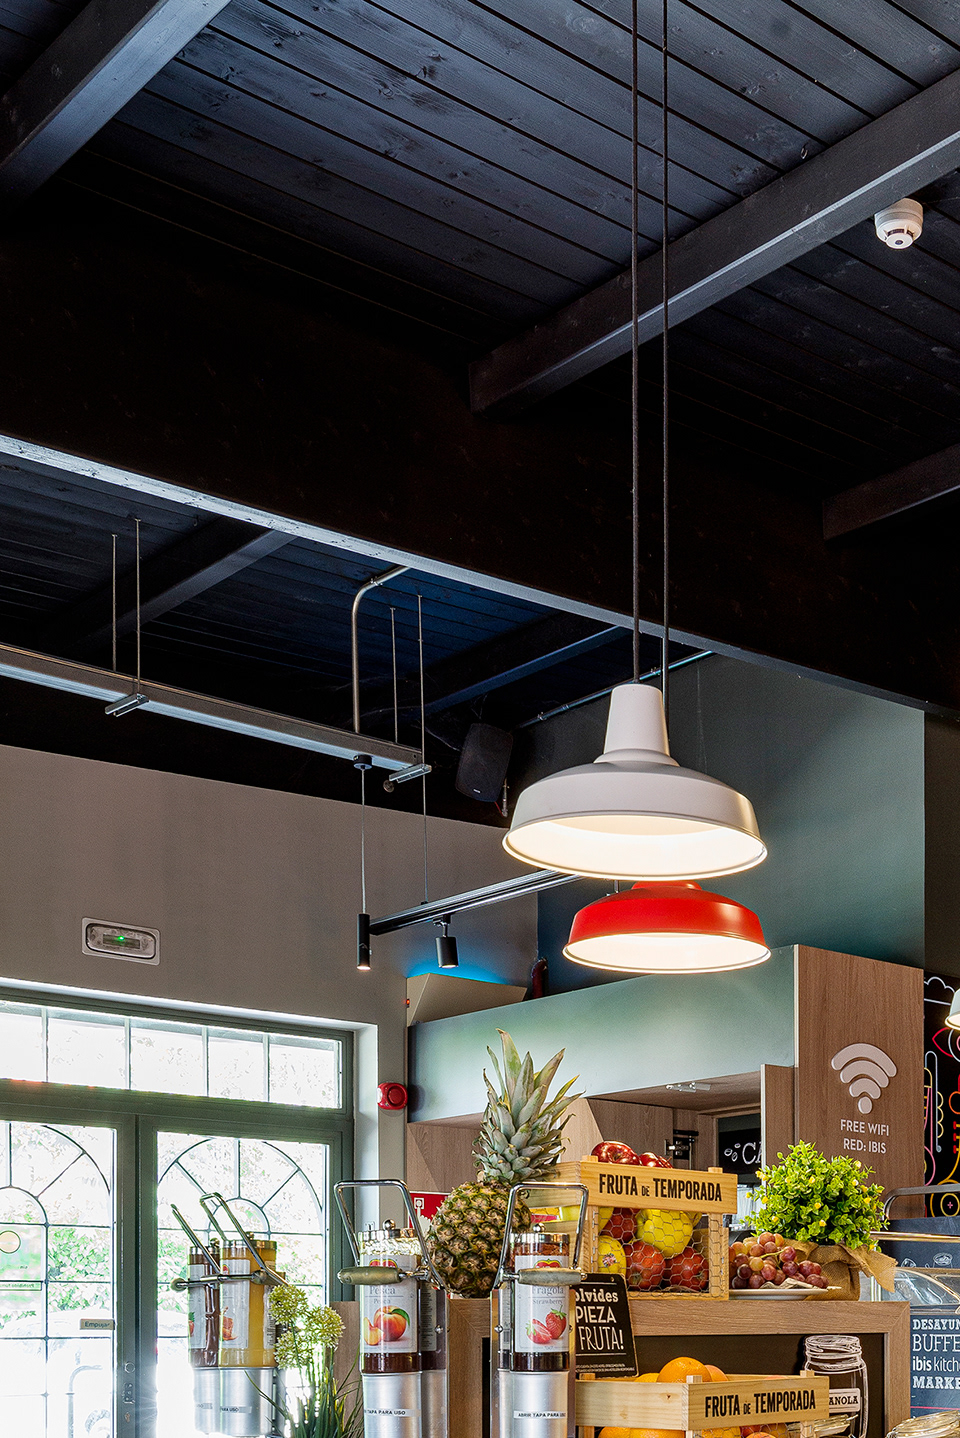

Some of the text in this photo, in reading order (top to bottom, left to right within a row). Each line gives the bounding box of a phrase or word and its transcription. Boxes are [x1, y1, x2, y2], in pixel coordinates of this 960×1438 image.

[840, 1118, 889, 1136] FREE WIFI
[843, 1137, 887, 1154] RED: IBIS
[599, 1173, 638, 1196] FRUTA
[653, 1178, 722, 1202] TEMPORADA
[575, 1305, 617, 1324] PIEZA
[578, 1326, 625, 1351] FRUTA!
[912, 1356, 932, 1371] ibis
[705, 1390, 816, 1418] FRUTA DE TEMPORADA
[829, 1395, 858, 1405] ANOLA
